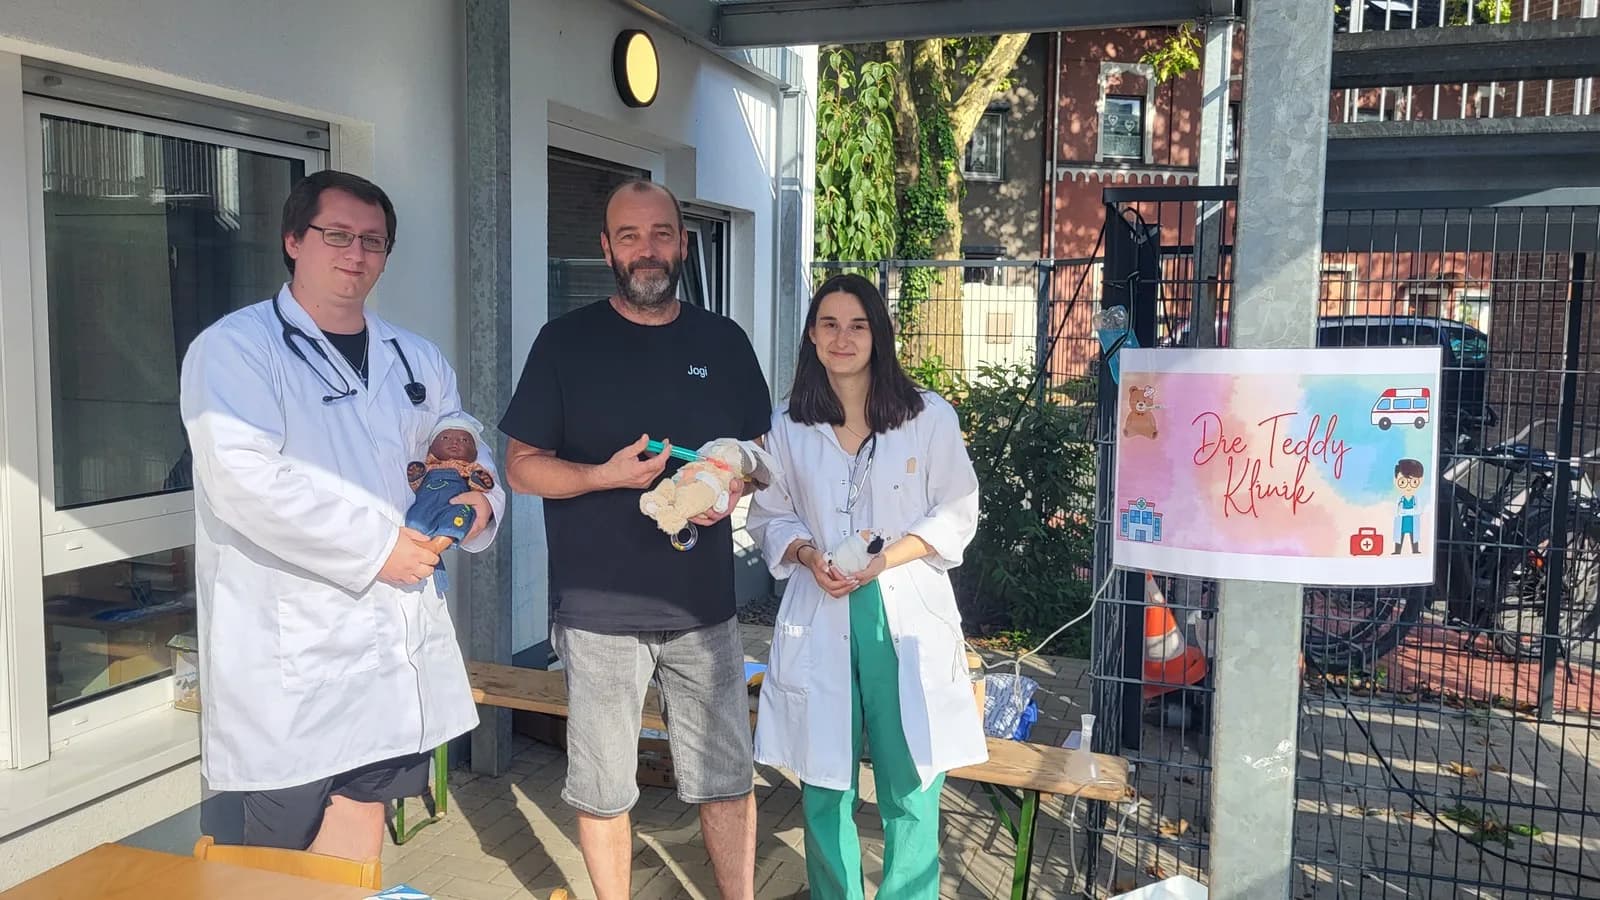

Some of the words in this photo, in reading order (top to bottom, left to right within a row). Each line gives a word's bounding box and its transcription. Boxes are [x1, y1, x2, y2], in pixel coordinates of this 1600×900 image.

[687, 364, 708, 378] Jogi
[1191, 412, 1248, 466] Die
[1257, 412, 1352, 479] Teddy
[1223, 456, 1315, 518] Klinik
